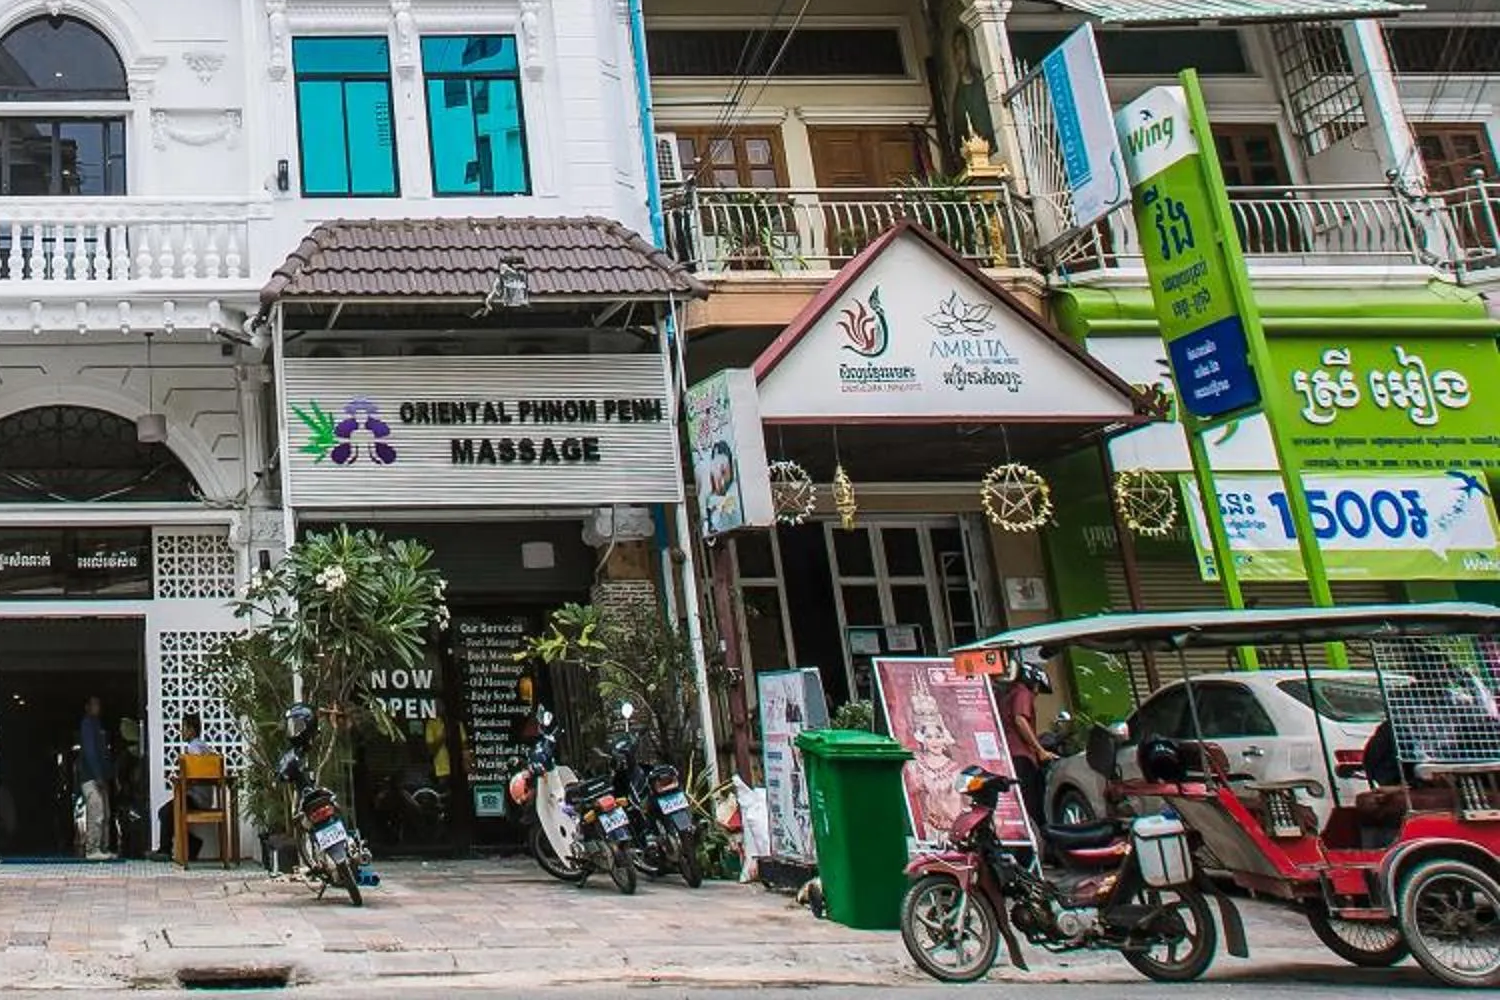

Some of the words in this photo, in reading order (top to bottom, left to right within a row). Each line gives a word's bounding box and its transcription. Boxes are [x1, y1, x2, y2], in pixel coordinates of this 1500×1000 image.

[1127, 115, 1174, 157] Wing
[930, 340, 1009, 358] AMRITA
[400, 401, 513, 425] ORIENTAL
[518, 401, 597, 424] PHNOM
[604, 400, 663, 423] PENH
[451, 438, 600, 465] MASSAGE
[481, 624, 523, 633] Services
[370, 669, 433, 689] NOW
